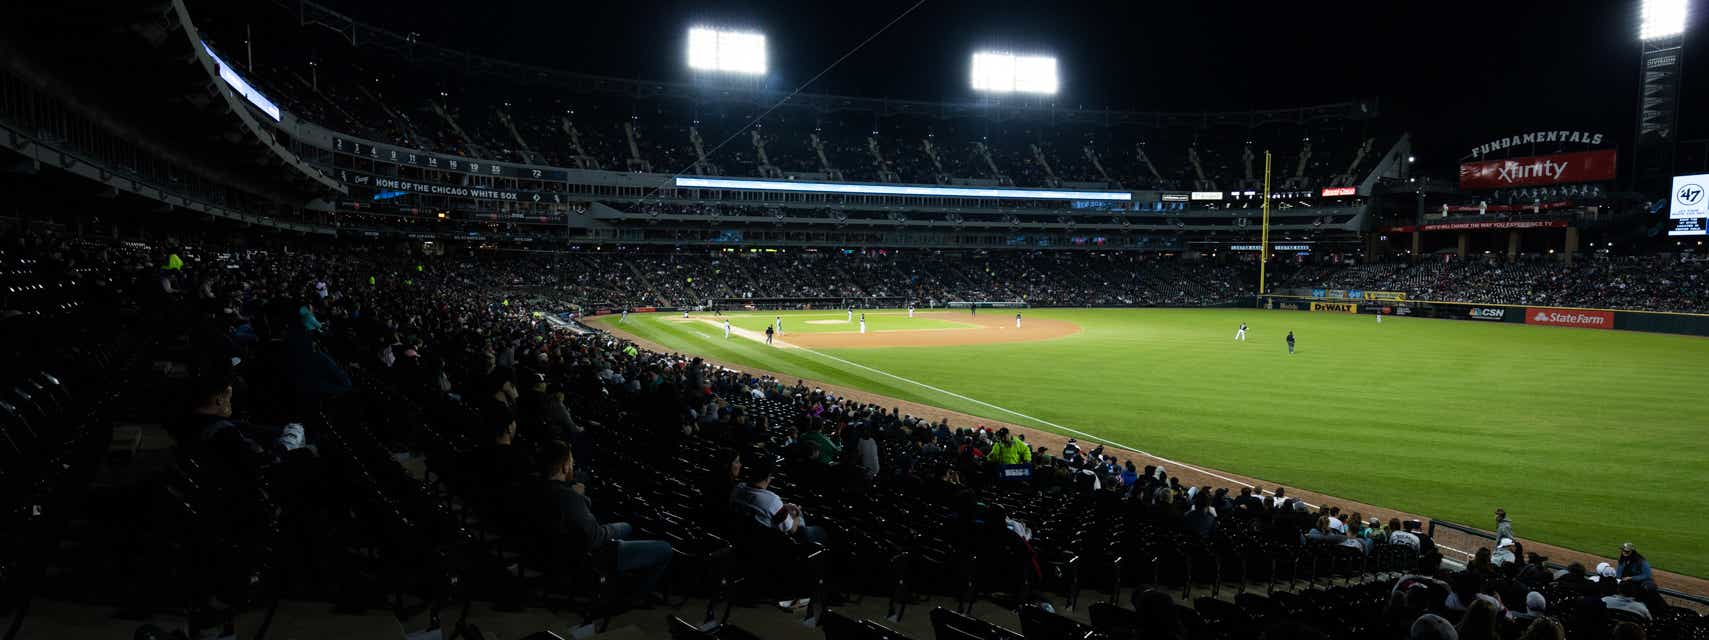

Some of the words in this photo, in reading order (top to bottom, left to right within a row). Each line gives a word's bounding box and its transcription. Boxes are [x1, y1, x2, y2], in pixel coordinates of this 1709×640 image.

[1471, 130, 1604, 158] FUNDAMENTALS
[376, 179, 400, 188] HOME
[401, 182, 412, 190] OF
[414, 184, 429, 192] THE
[432, 186, 468, 196] CHICAGO
[470, 189, 499, 198] WHITE
[501, 192, 517, 200] SOX
[1483, 308, 1504, 317] CSN
